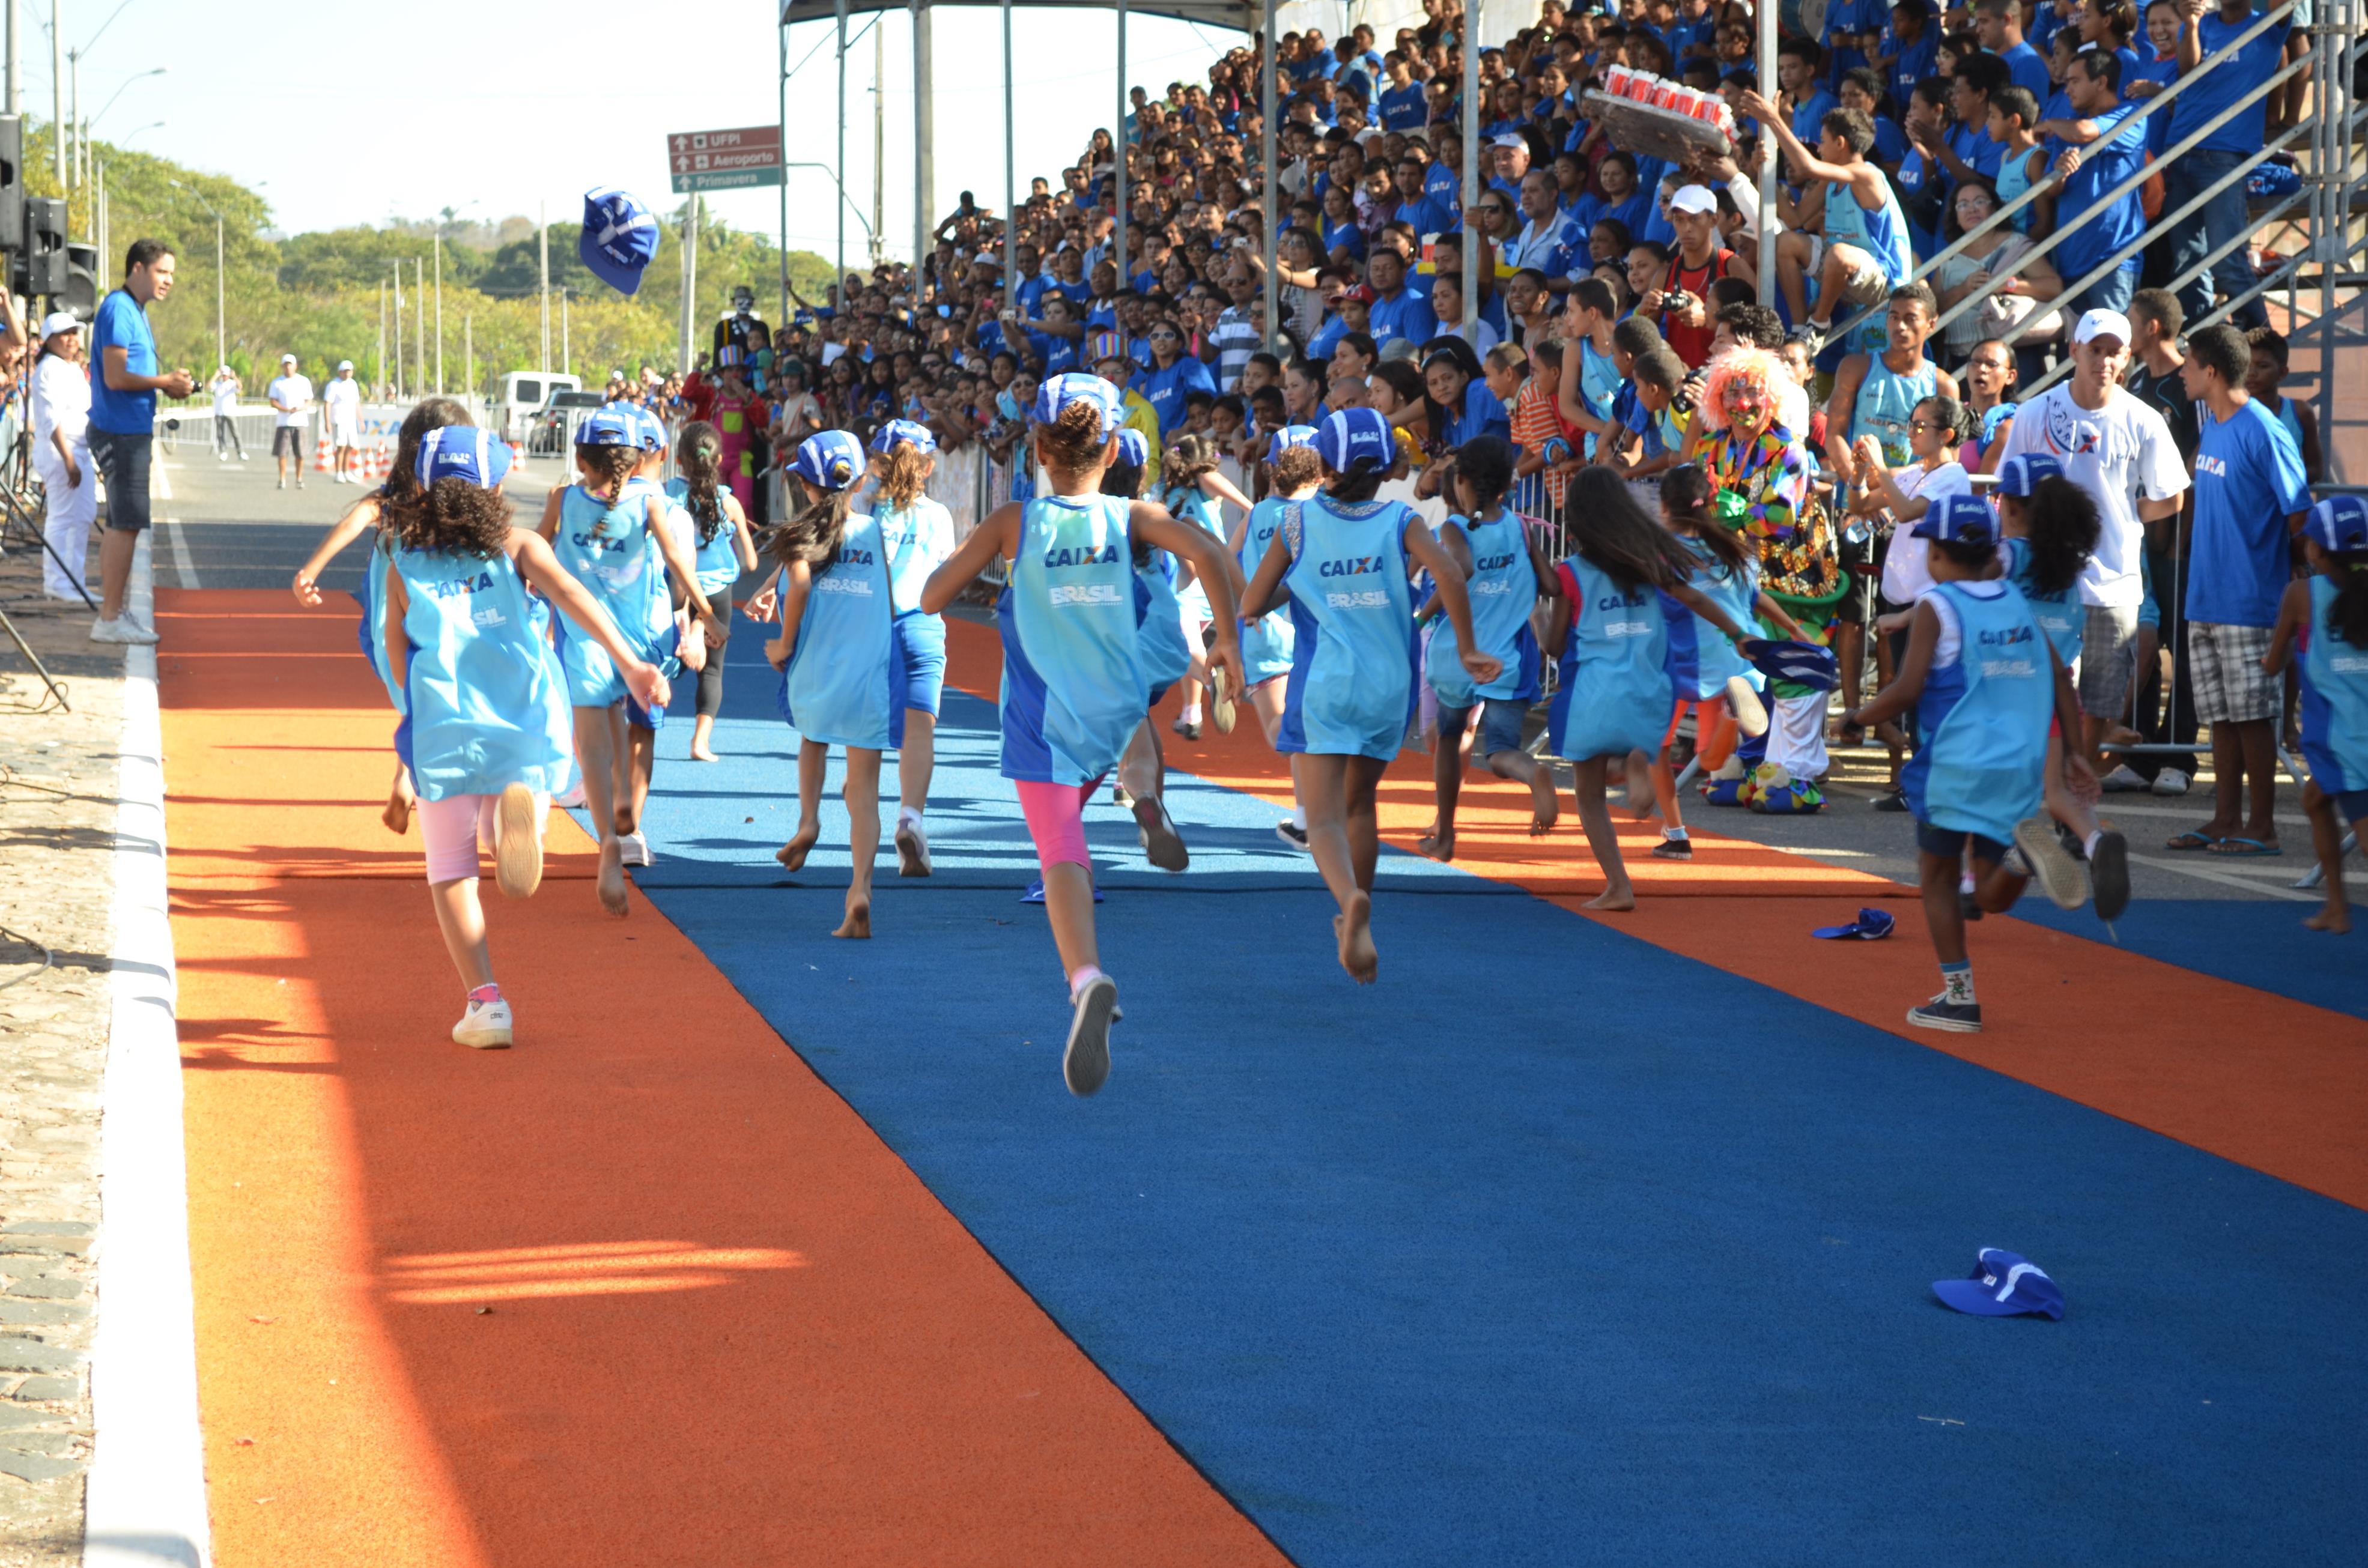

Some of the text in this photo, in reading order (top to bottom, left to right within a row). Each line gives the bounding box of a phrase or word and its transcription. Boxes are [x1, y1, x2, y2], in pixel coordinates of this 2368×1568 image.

[711, 133, 740, 147] UFPI
[713, 152, 774, 168] Aeroporto
[697, 174, 757, 187] Primavera
[363, 419, 401, 435] IXA
[2195, 454, 2226, 477] AIXA
[572, 533, 625, 552] CAXA
[882, 528, 918, 545] CAIX
[837, 549, 873, 566] IXA
[1045, 545, 1119, 568] CAIXA
[1320, 556, 1384, 577] CAIXA
[427, 572, 494, 599] AIXA
[819, 577, 873, 595] BRASIL
[1049, 584, 1123, 605] BRASIL
[1326, 590, 1391, 608] BRASIL
[1599, 593, 1647, 611] CAIA
[473, 608, 506, 625] SIL
